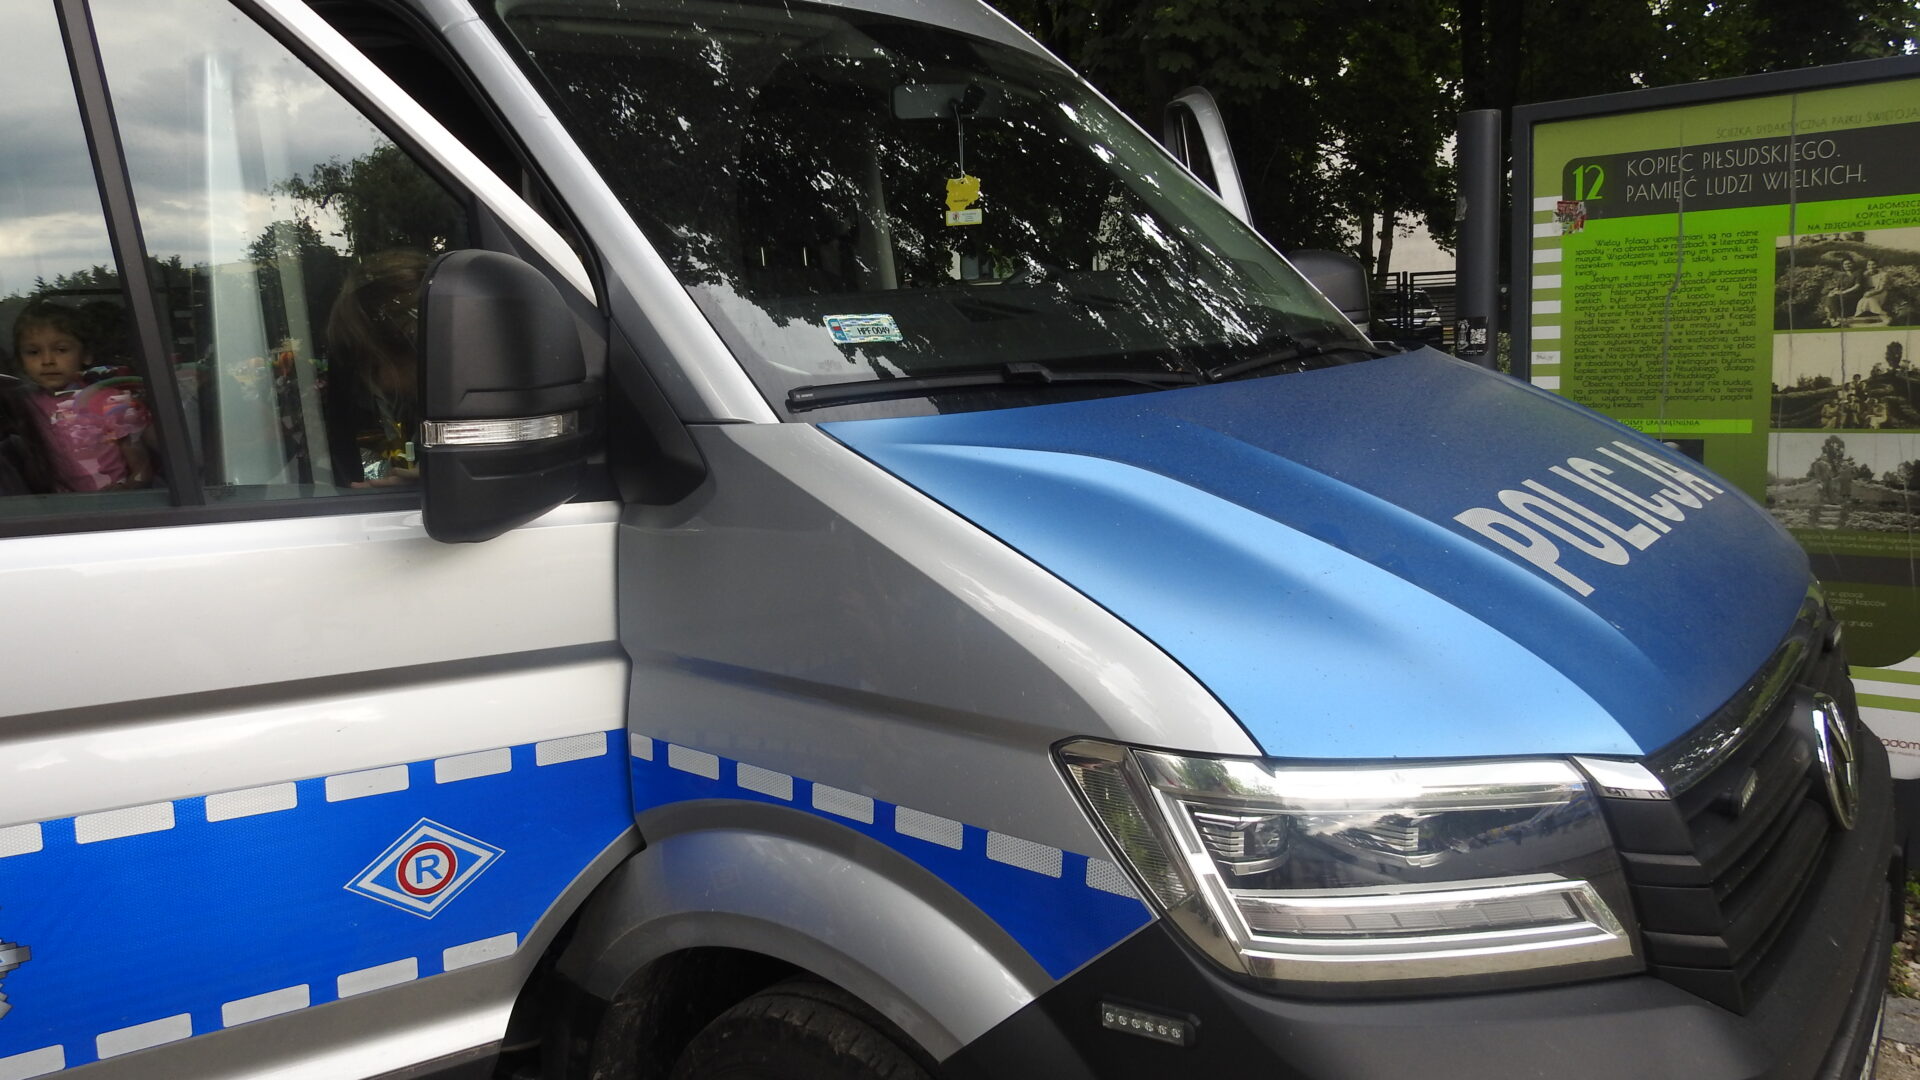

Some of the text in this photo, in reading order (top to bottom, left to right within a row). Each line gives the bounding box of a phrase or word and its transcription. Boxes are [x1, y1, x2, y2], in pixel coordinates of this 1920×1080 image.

[1626, 138, 1841, 178] KOPIEC PIŁSUDSKIEGO.
[1571, 164, 1605, 201] 12
[1626, 163, 1867, 202] PAMIĘĆ LUDZI WIELKICH.
[1453, 441, 1724, 597] POLICJA
[1880, 738, 1920, 751] adom
[415, 853, 443, 885] R
